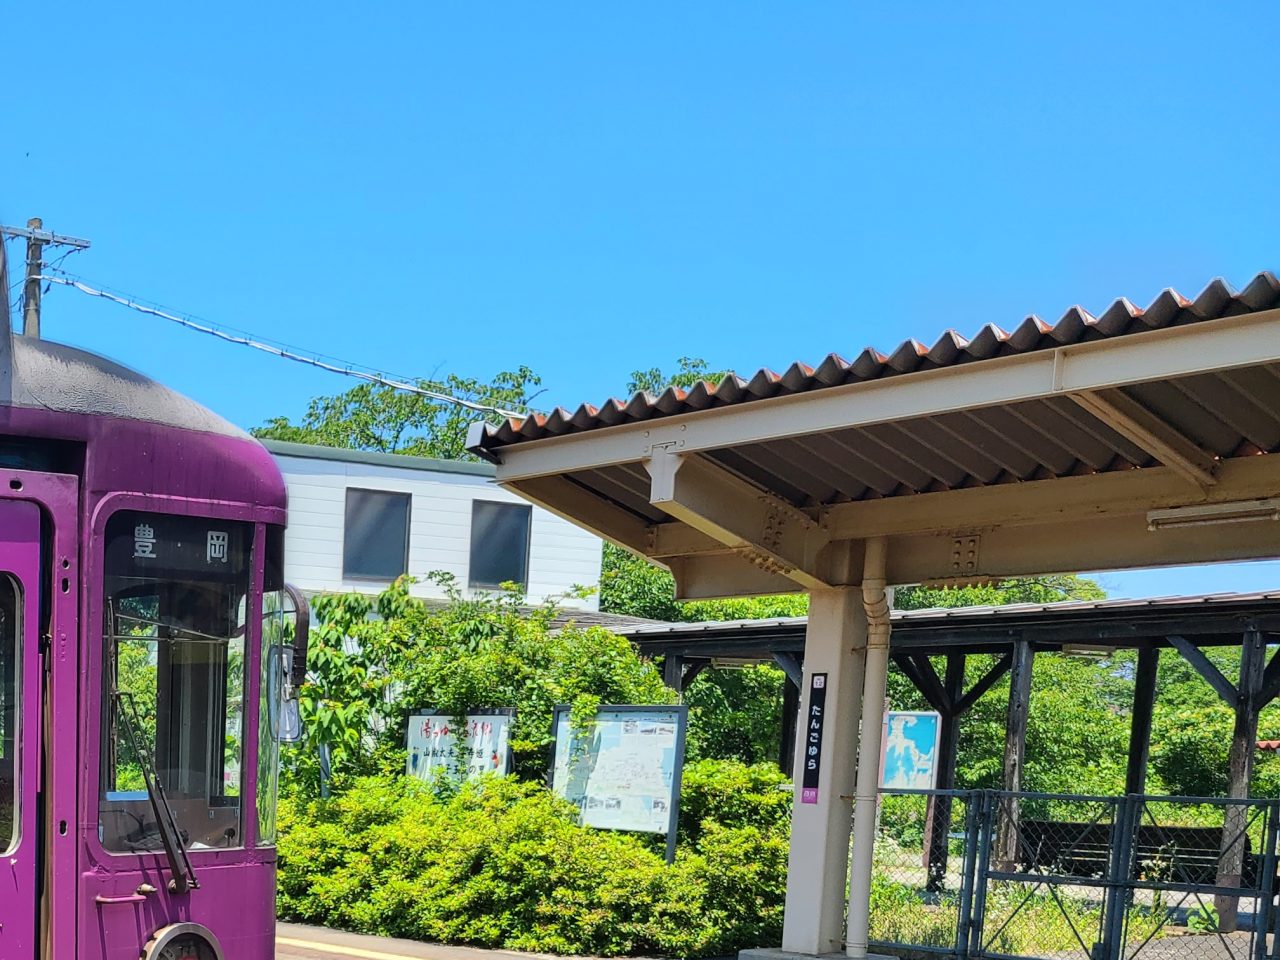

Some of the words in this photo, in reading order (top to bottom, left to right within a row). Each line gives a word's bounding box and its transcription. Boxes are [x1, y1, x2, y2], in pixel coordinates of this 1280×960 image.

[134, 524, 229, 564] 豊岡
[807, 705, 821, 770] たんごゆら
